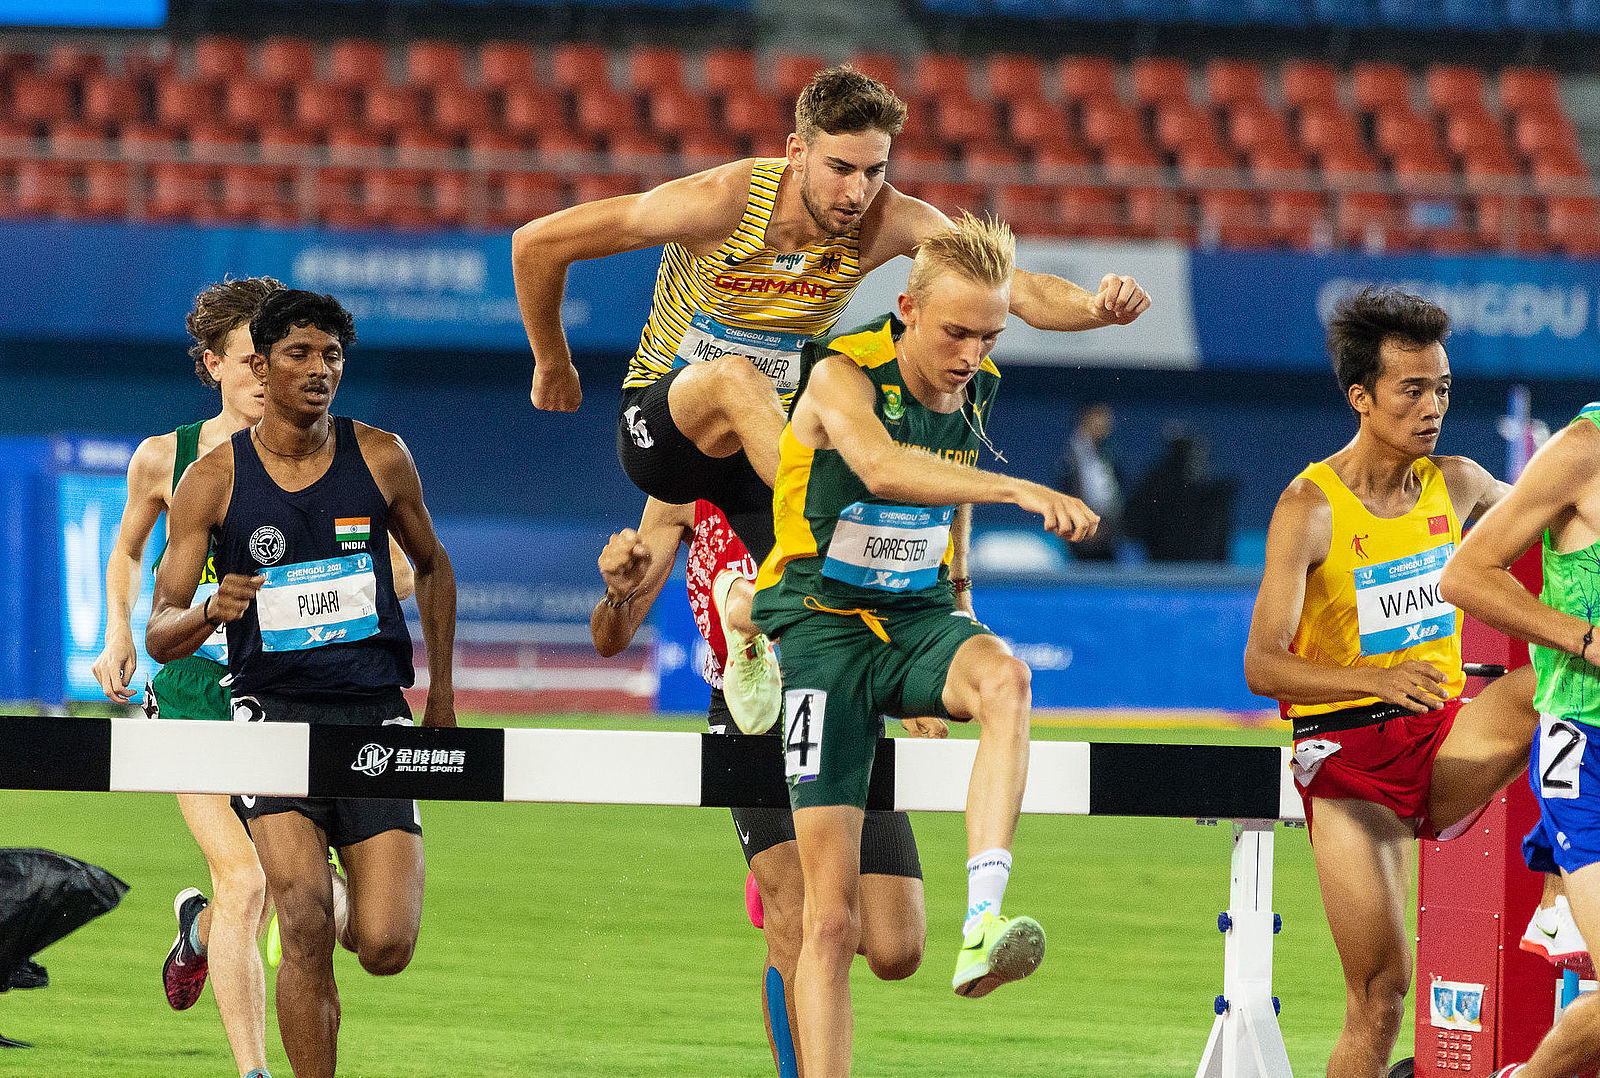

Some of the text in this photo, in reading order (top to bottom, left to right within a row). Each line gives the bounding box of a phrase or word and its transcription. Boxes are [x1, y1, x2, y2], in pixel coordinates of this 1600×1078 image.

[715, 275, 832, 300] GERMANY
[1317, 279, 1589, 338] CNGDU
[725, 328, 764, 341] CHENGDU
[765, 335, 782, 344] 2021
[693, 340, 790, 380] MERHALER
[776, 380, 791, 388] 1260
[880, 511, 918, 521] CHENGDU
[341, 541, 366, 550] INDIA
[863, 536, 928, 562] FORRESTER
[286, 566, 325, 577] CHENGDU
[327, 563, 342, 571] 2021
[1389, 559, 1423, 574] CHENGDU
[298, 590, 340, 617] PUJARI
[787, 694, 818, 766] 4
[395, 748, 466, 765] 金陵体育
[1543, 722, 1580, 789] 2
[430, 765, 464, 773] SPORTS
